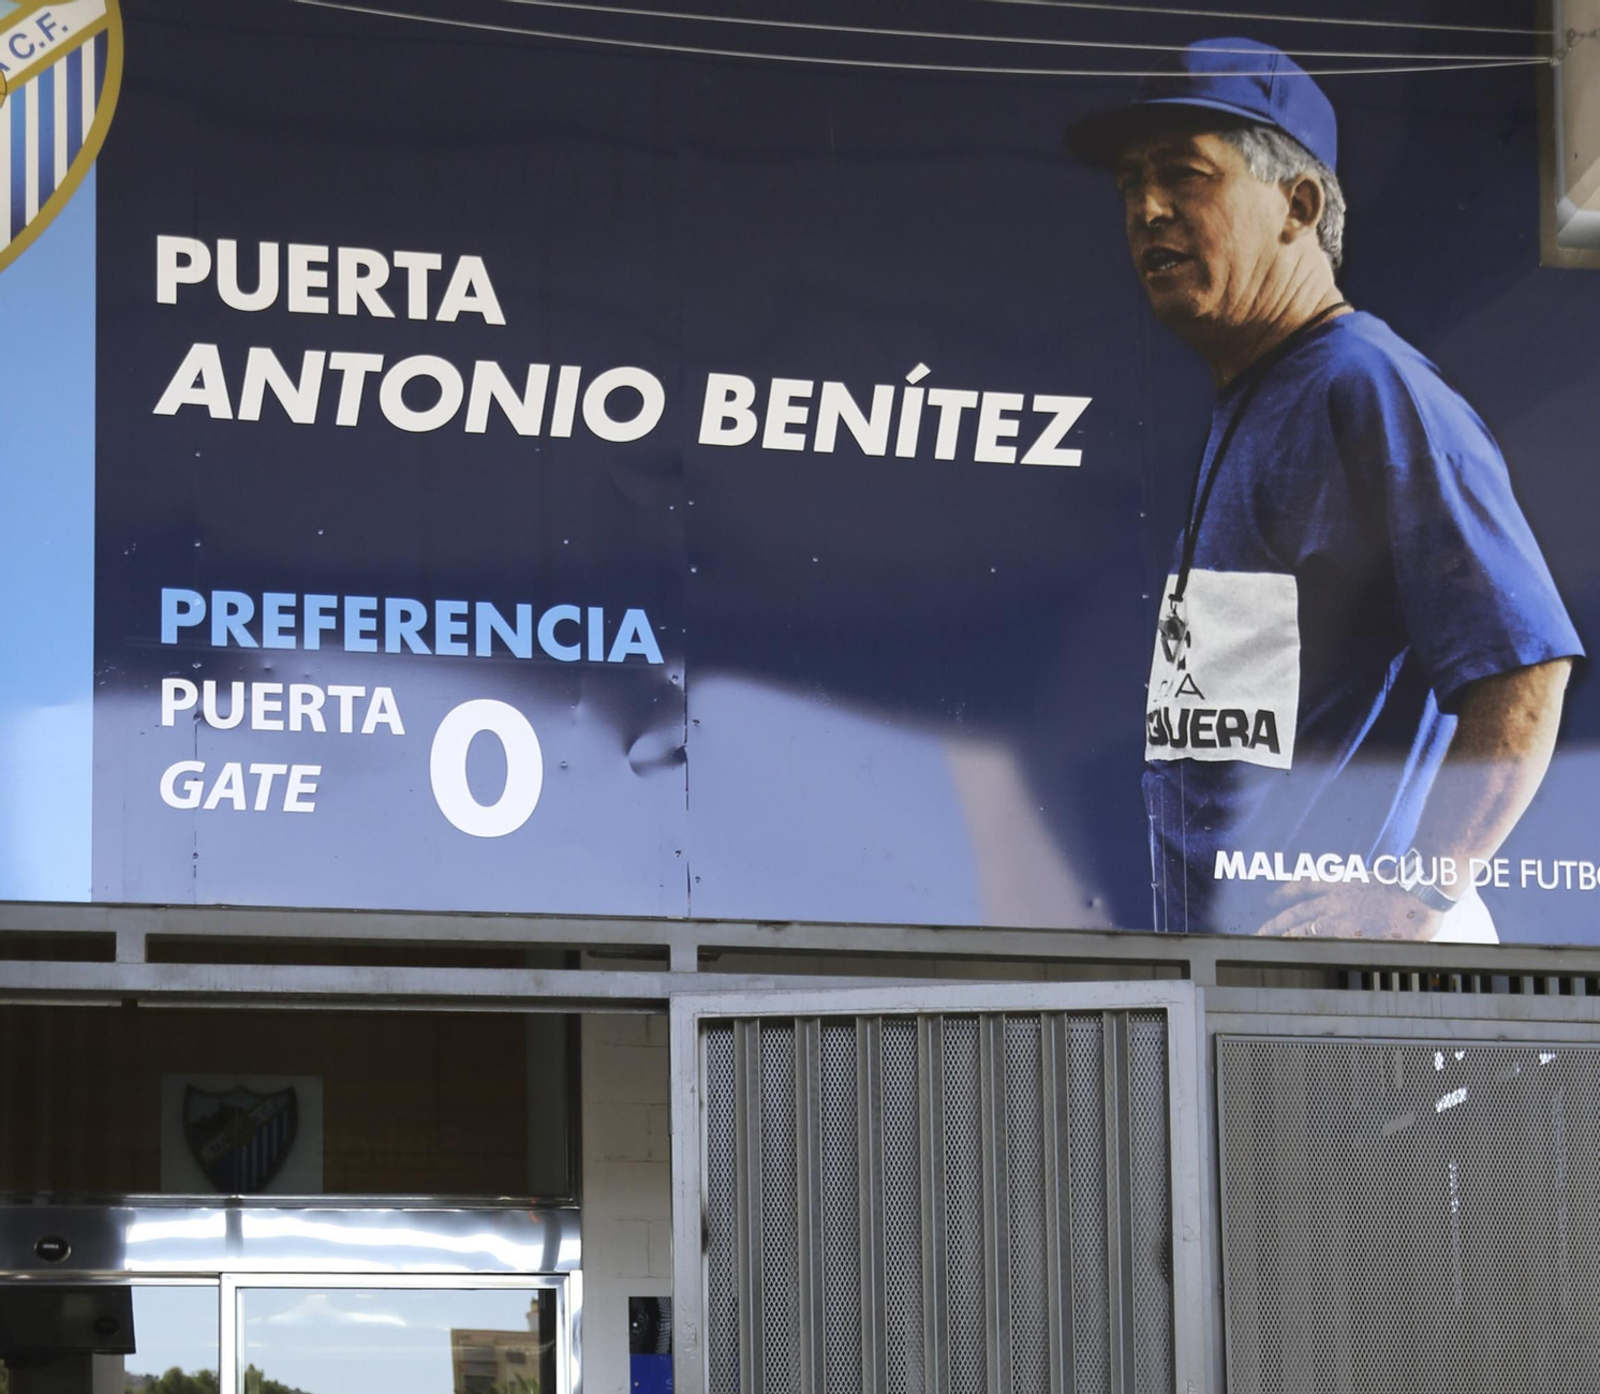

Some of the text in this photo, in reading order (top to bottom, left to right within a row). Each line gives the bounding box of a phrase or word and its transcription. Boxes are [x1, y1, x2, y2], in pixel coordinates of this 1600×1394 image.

[156, 235, 506, 326] PUERTA
[152, 342, 1093, 467] ANTONIO BENÍTEZ
[161, 587, 665, 664] PREFERENCIA
[161, 678, 406, 735] PUERTA
[159, 760, 322, 813] GATE
[1468, 857, 1510, 888] DE
[1520, 858, 1600, 891] FUTB
